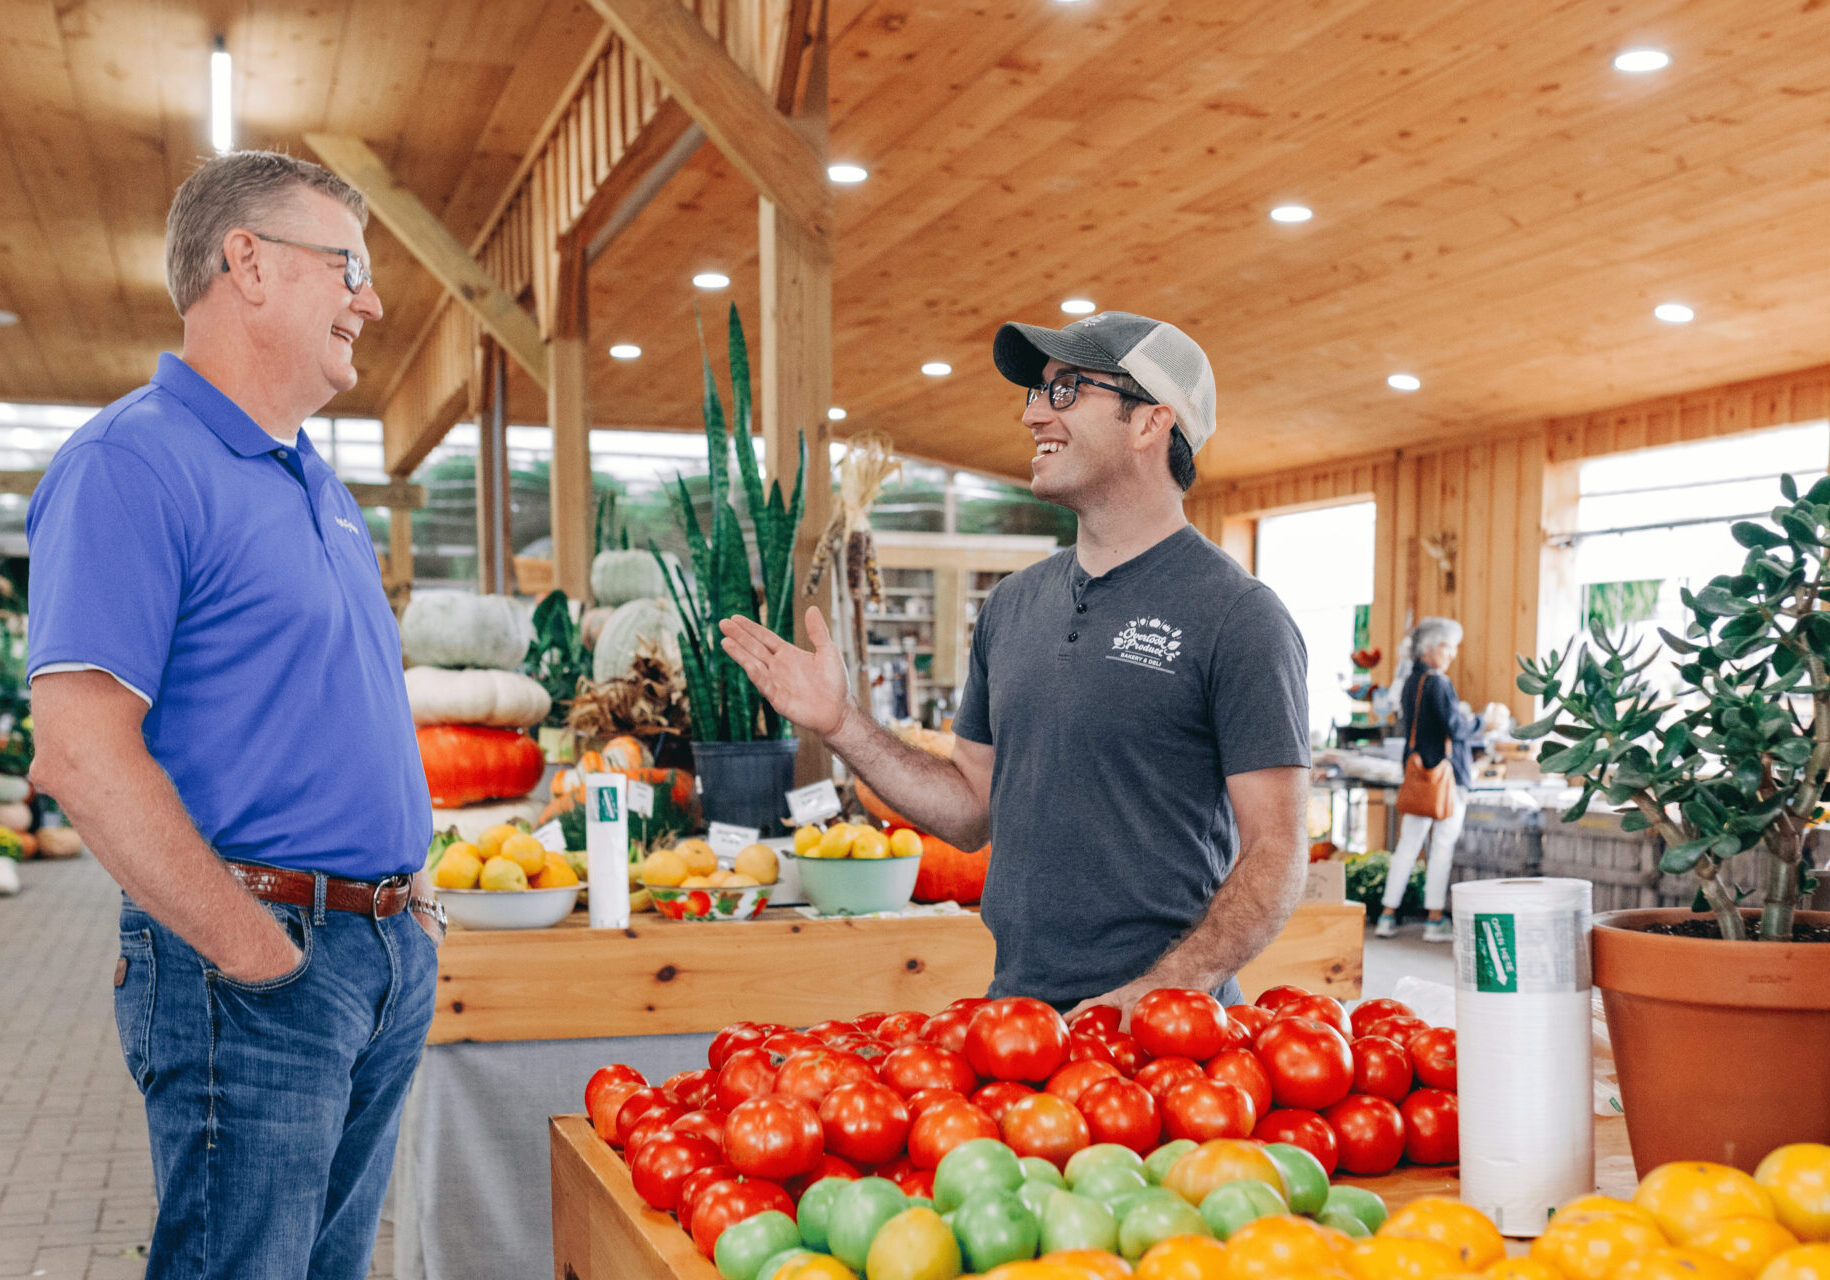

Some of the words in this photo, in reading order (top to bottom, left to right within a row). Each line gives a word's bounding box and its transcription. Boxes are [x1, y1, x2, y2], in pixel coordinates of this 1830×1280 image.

[1125, 639, 1165, 656] Produce
[1120, 652, 1143, 662] BAKERY
[1148, 659, 1162, 667] DELI
[1491, 917, 1505, 946] OPEN
